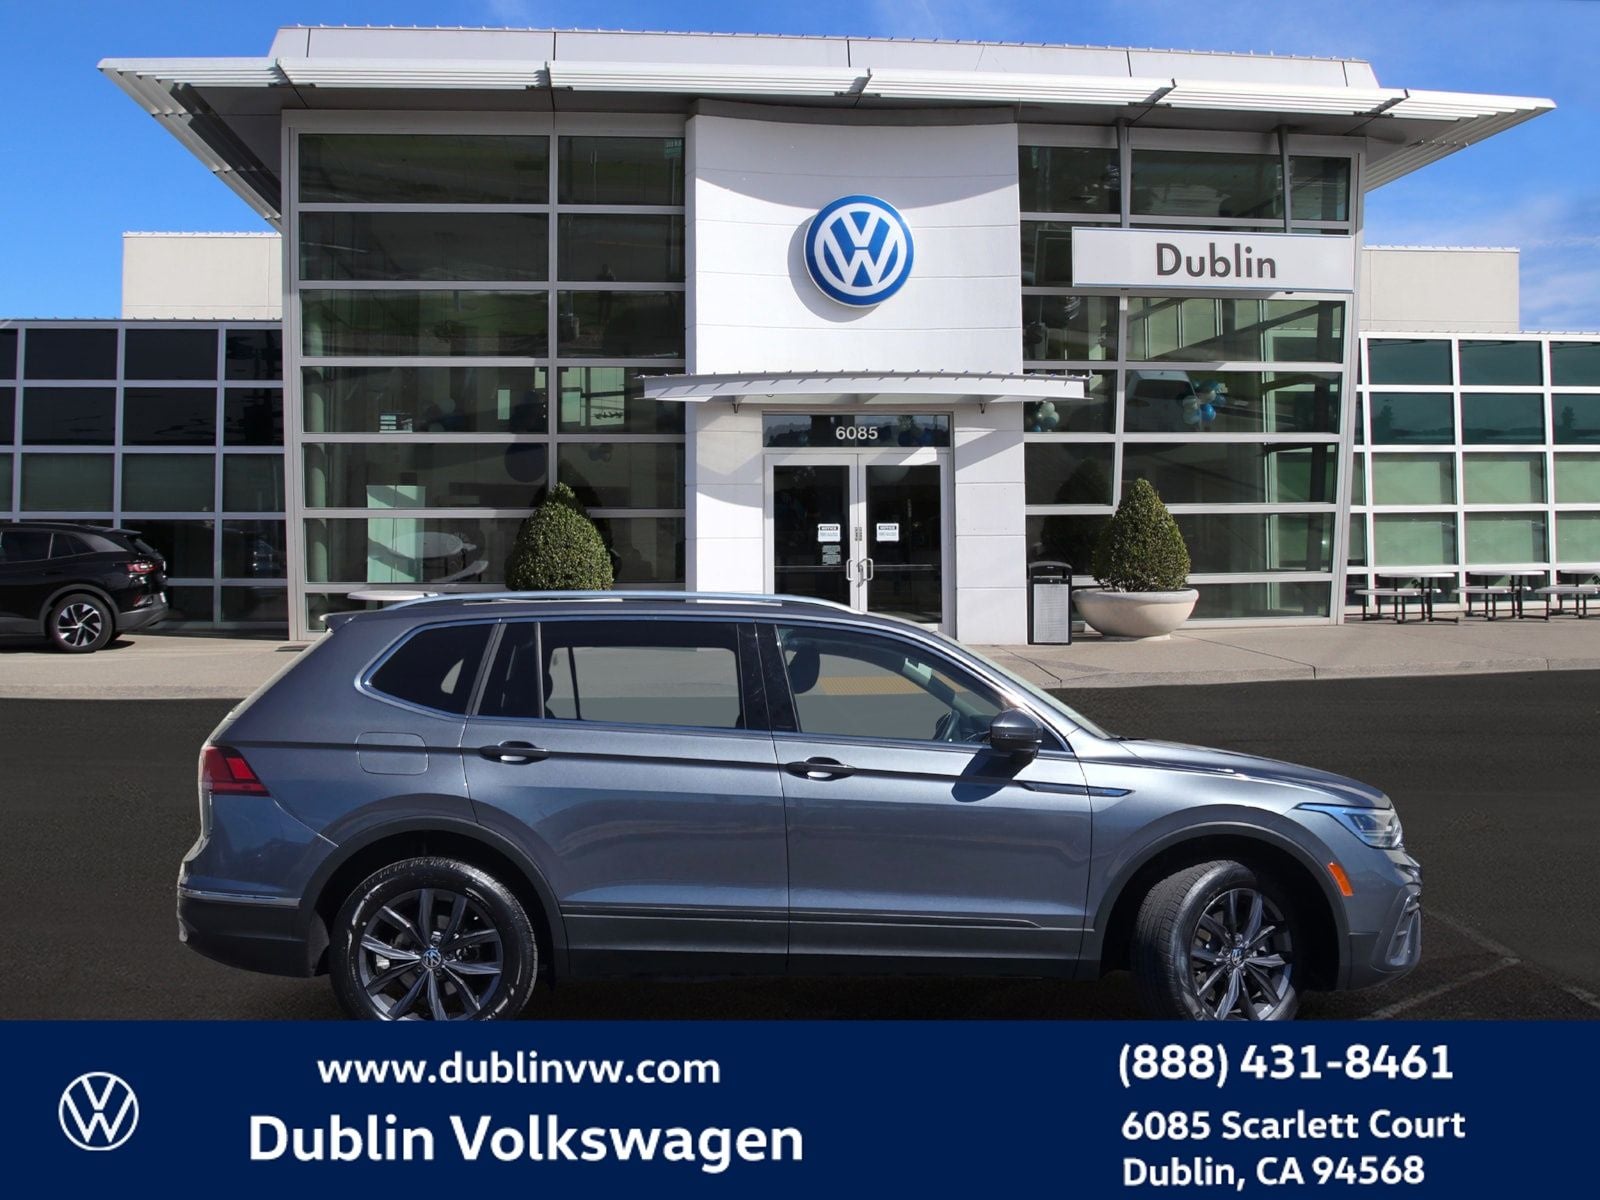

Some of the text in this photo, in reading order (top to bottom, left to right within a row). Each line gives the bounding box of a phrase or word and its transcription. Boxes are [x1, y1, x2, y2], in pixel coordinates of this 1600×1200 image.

[811, 202, 907, 299] VW
[1155, 241, 1277, 279] Dublin
[835, 426, 879, 440] 6085
